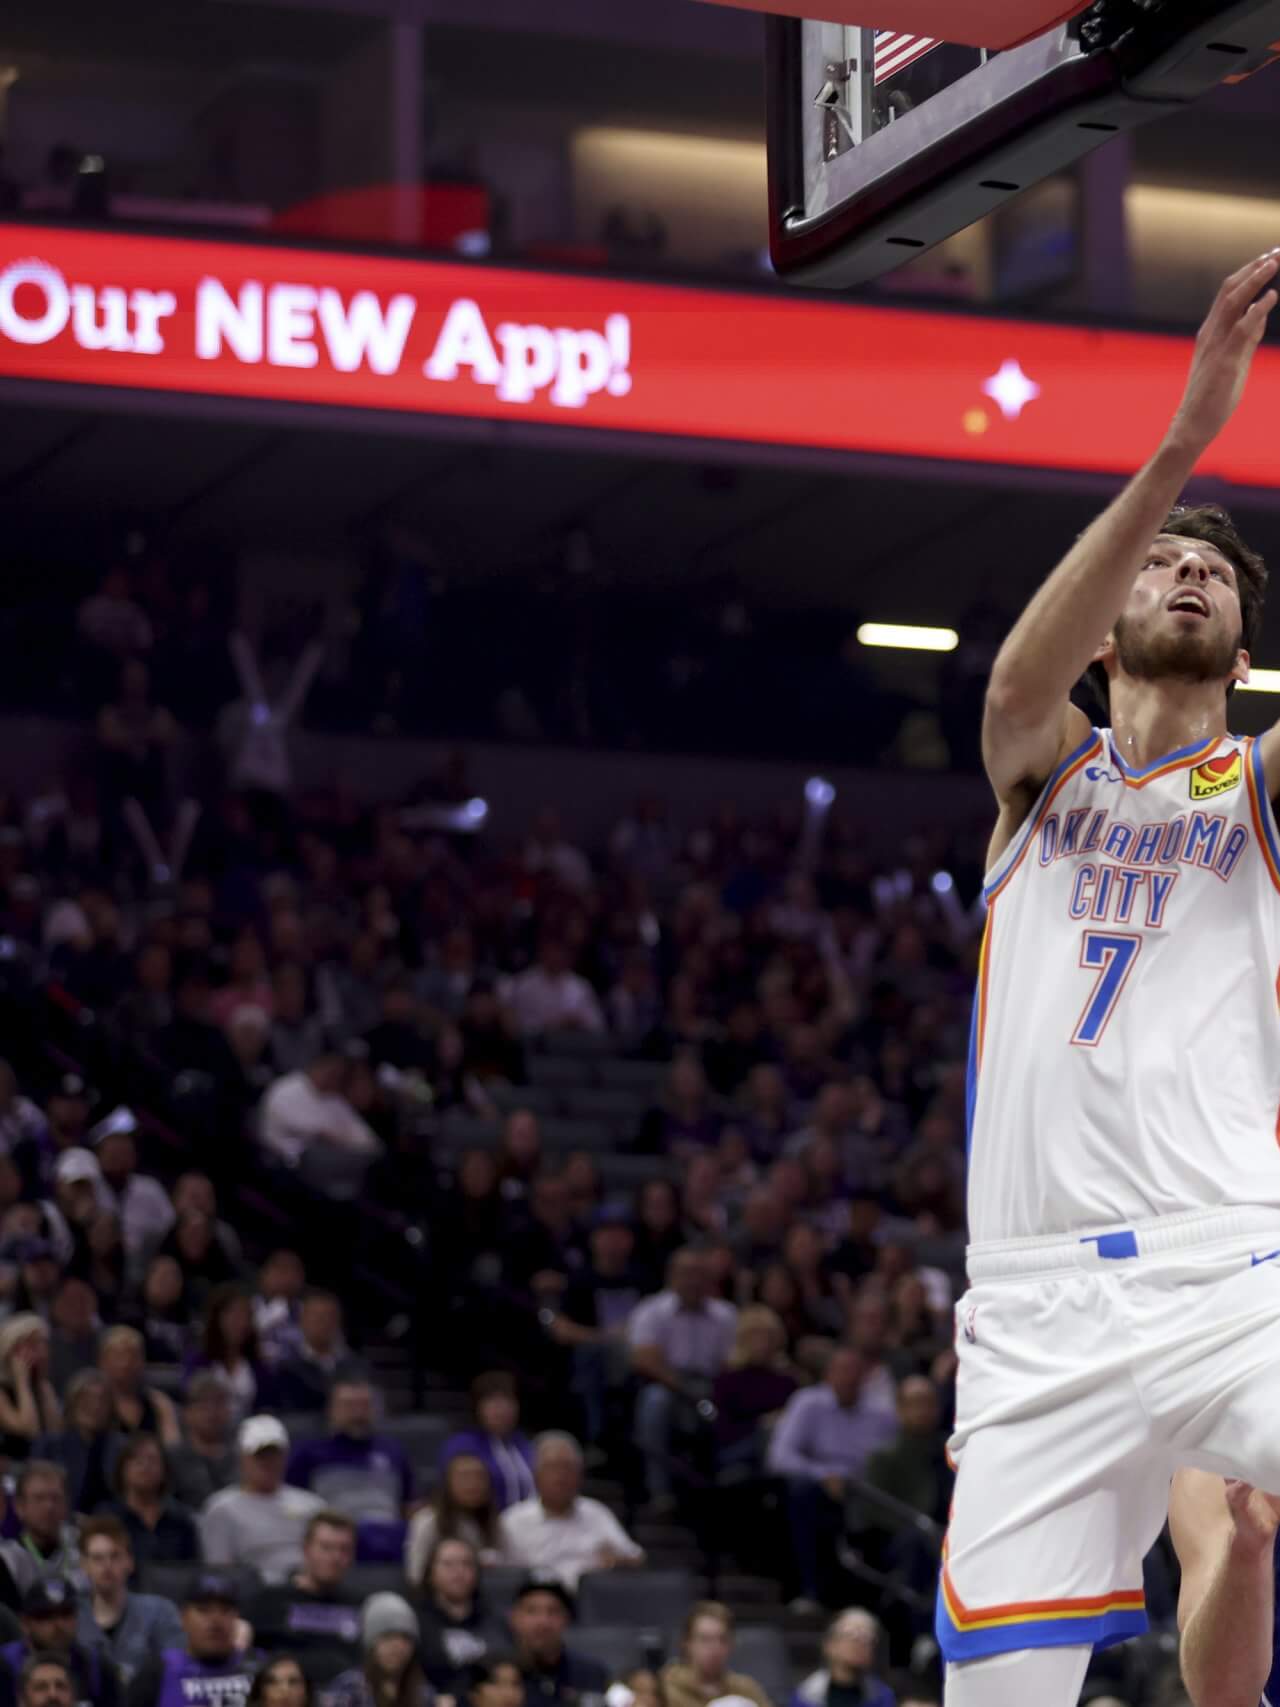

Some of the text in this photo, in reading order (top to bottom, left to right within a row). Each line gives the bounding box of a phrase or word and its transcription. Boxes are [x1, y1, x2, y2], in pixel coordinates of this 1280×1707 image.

[0, 259, 632, 408] Our NEW App!
[1039, 808, 1249, 882] OKLAHOMA
[1069, 864, 1178, 928] CITY
[1070, 929, 1143, 1047] 7
